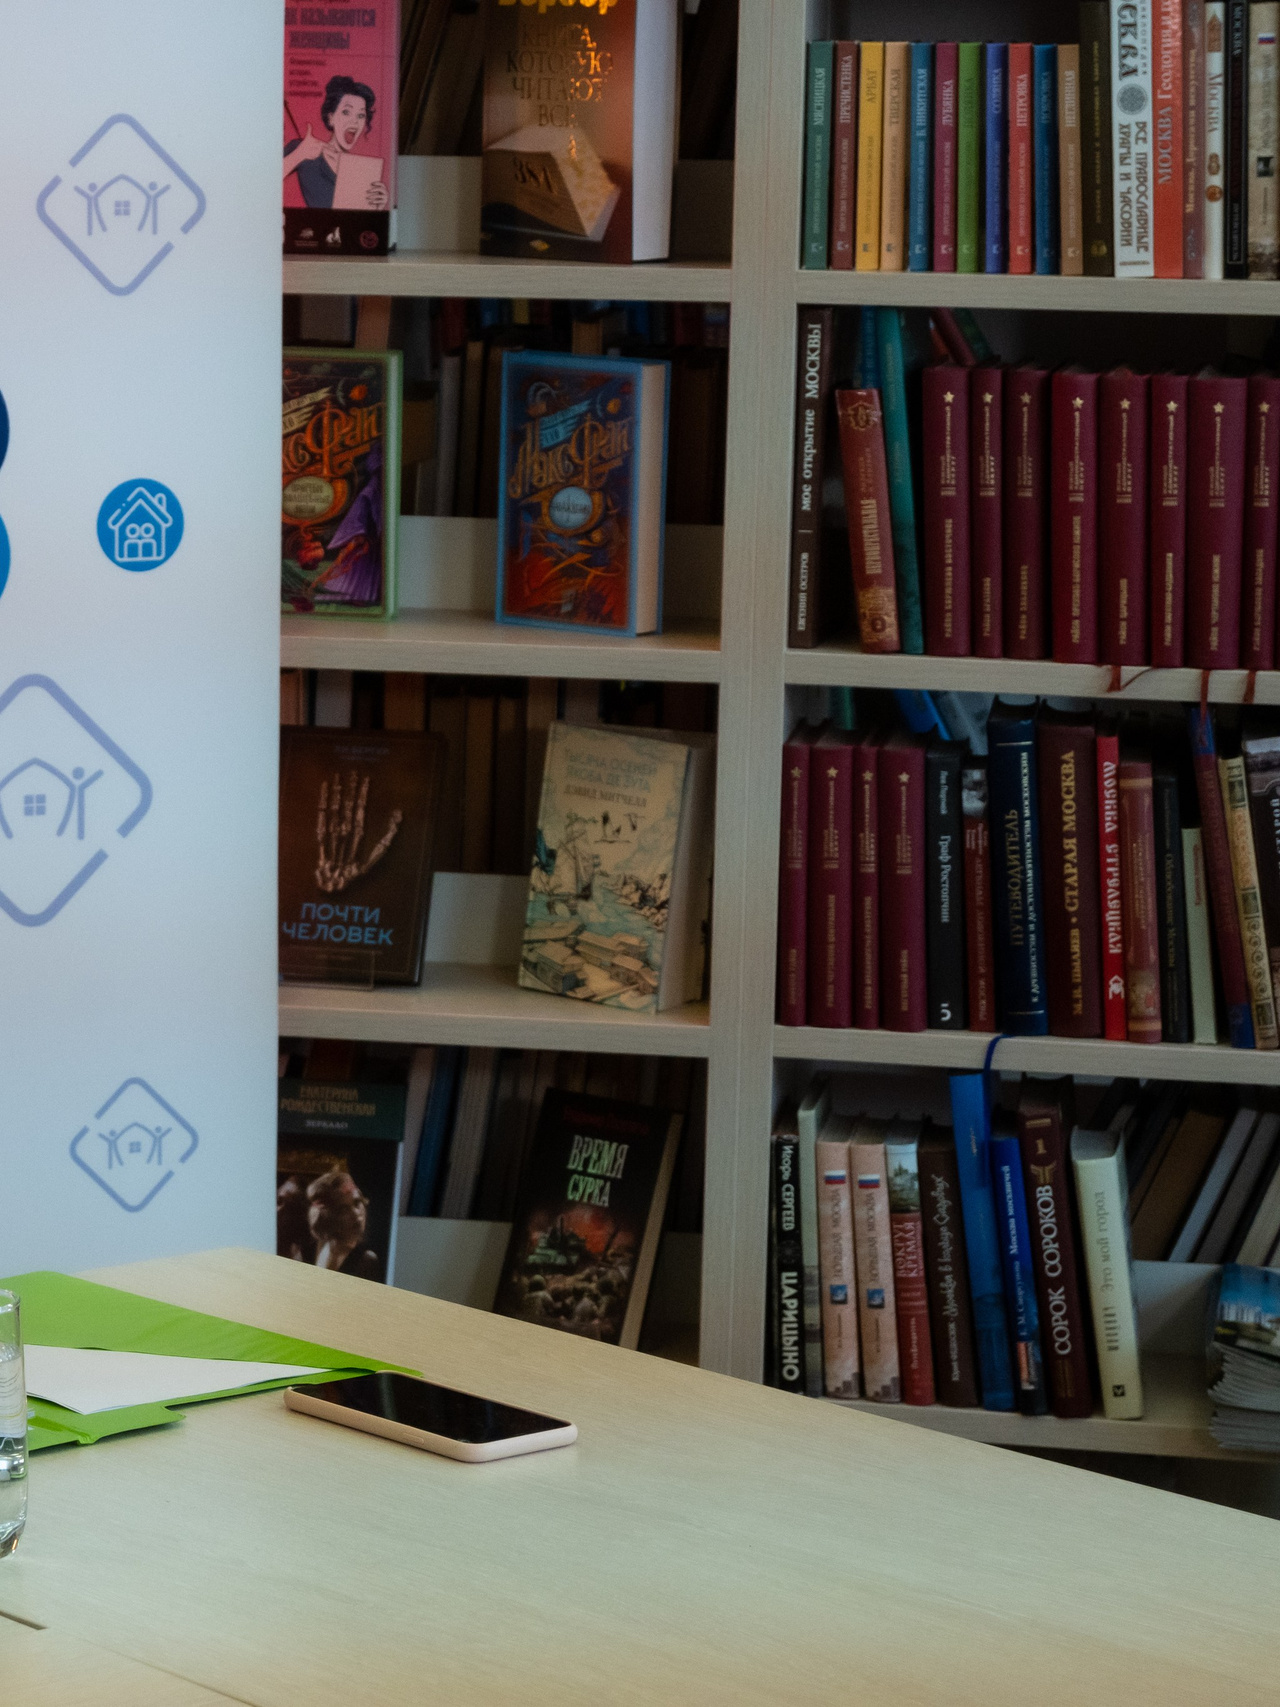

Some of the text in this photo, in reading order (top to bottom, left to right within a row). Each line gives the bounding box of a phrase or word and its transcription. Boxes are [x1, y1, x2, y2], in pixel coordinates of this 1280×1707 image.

[1117, 0, 1139, 81] СКВА
[813, 68, 825, 125] МЯСНИЦКАЯ
[839, 56, 853, 123] ПРЕЧИСТЕНКА
[866, 69, 877, 103] АРБАТ
[889, 69, 901, 126] ТВЕРСКАЯ
[916, 69, 927, 126] НИКИТСКАЯ
[942, 80, 954, 126] ЛУБЯНКА
[1016, 74, 1028, 127] ПЕТРОВКА
[1064, 70, 1076, 127] НЕГЛИННАЯ
[1159, 107, 1172, 183] МОСКВА
[1119, 123, 1133, 247] ХРАМЫ И ЧАСОВНИ
[1135, 122, 1149, 253] ВСЕ ПРАВОСЛАВНЫЕ
[800, 323, 822, 510] мое открытие МОСКВЫ
[797, 552, 809, 631] ЕВГЕНИЙ ОСЕТРОВ
[1061, 750, 1077, 830] МОСКВА
[938, 835, 952, 863] Граф
[1004, 809, 1025, 946] ПУТЕВОДИТЕЛЬ
[1063, 838, 1080, 912] СТАРАЯ
[1102, 761, 1122, 954] МОСКВА СТРЕЛЕЦКАЯ
[282, 922, 394, 946] ЧЕЛОВЕК
[301, 901, 381, 924] ПОЧТИ
[1069, 928, 1082, 983] ПЫЛЯЕВ
[566, 1134, 630, 1179] ВРЕМЯ
[566, 1173, 612, 1208] СУРКА
[1001, 1166, 1014, 1216] москвичей
[1093, 1191, 1111, 1233] город
[780, 1145, 799, 1381] Игорь СЕРГЕЕВ ЦАРИЦЫНО
[893, 1222, 907, 1277] ВОКРУГ
[905, 1222, 918, 1277] КРЕМЛЯ
[1008, 1218, 1019, 1255] Москва
[1096, 1238, 1111, 1264] мой
[1036, 1185, 1072, 1355] СОРОК СОРОКОВ
[1100, 1267, 1116, 1292] Это
